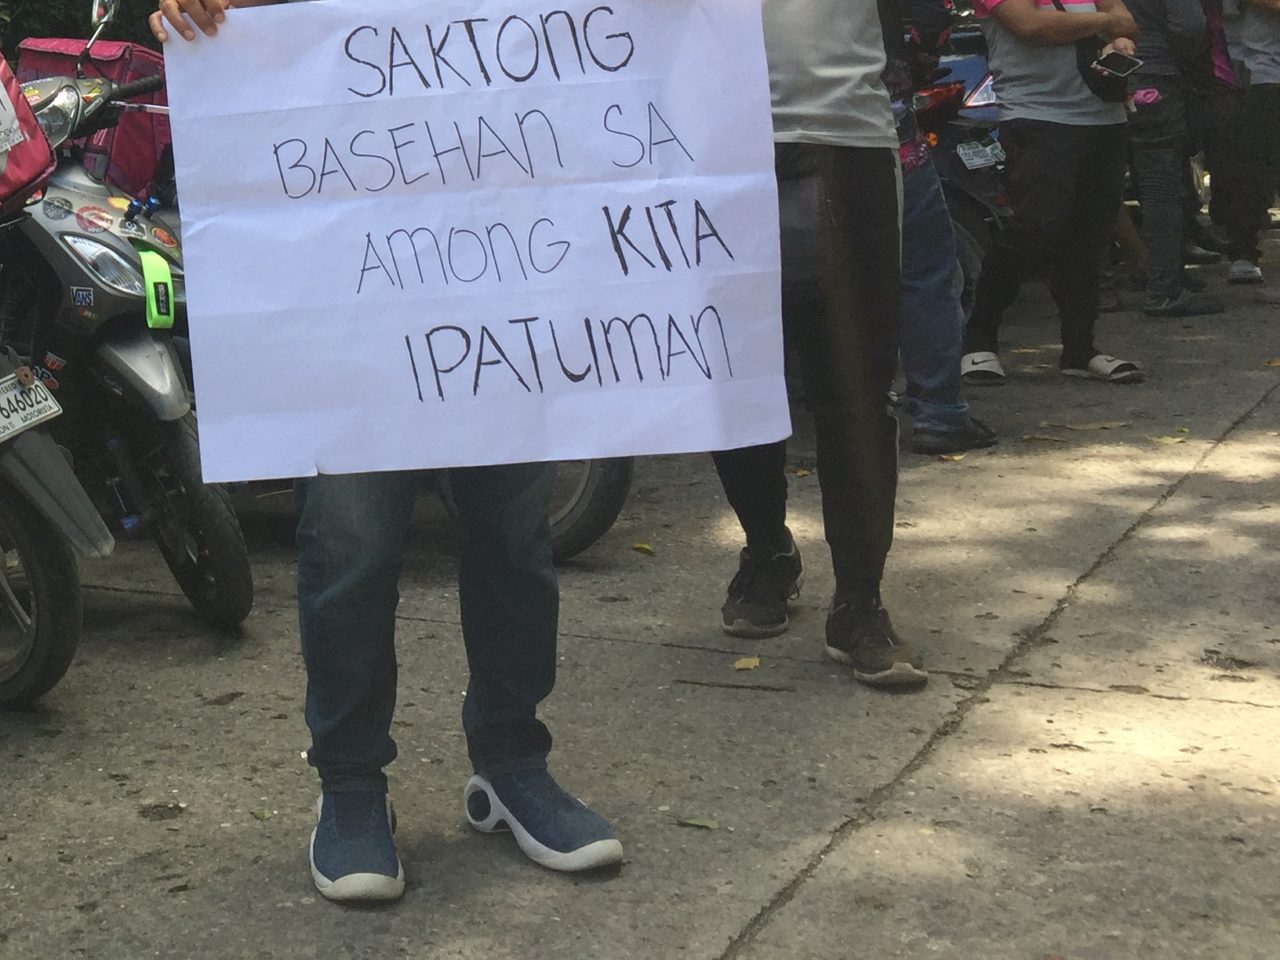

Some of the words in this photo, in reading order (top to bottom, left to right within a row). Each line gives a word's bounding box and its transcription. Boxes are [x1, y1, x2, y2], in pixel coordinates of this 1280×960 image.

[344, 6, 634, 98] SAKTONG
[273, 109, 564, 199] BASEHAN
[604, 101, 695, 168] SA
[357, 218, 571, 294] AMONG
[602, 199, 734, 276] KITA
[70, 286, 94, 306] VANS
[404, 305, 734, 403] IPATUMAN
[20, 404, 54, 423] MOTORISTA
